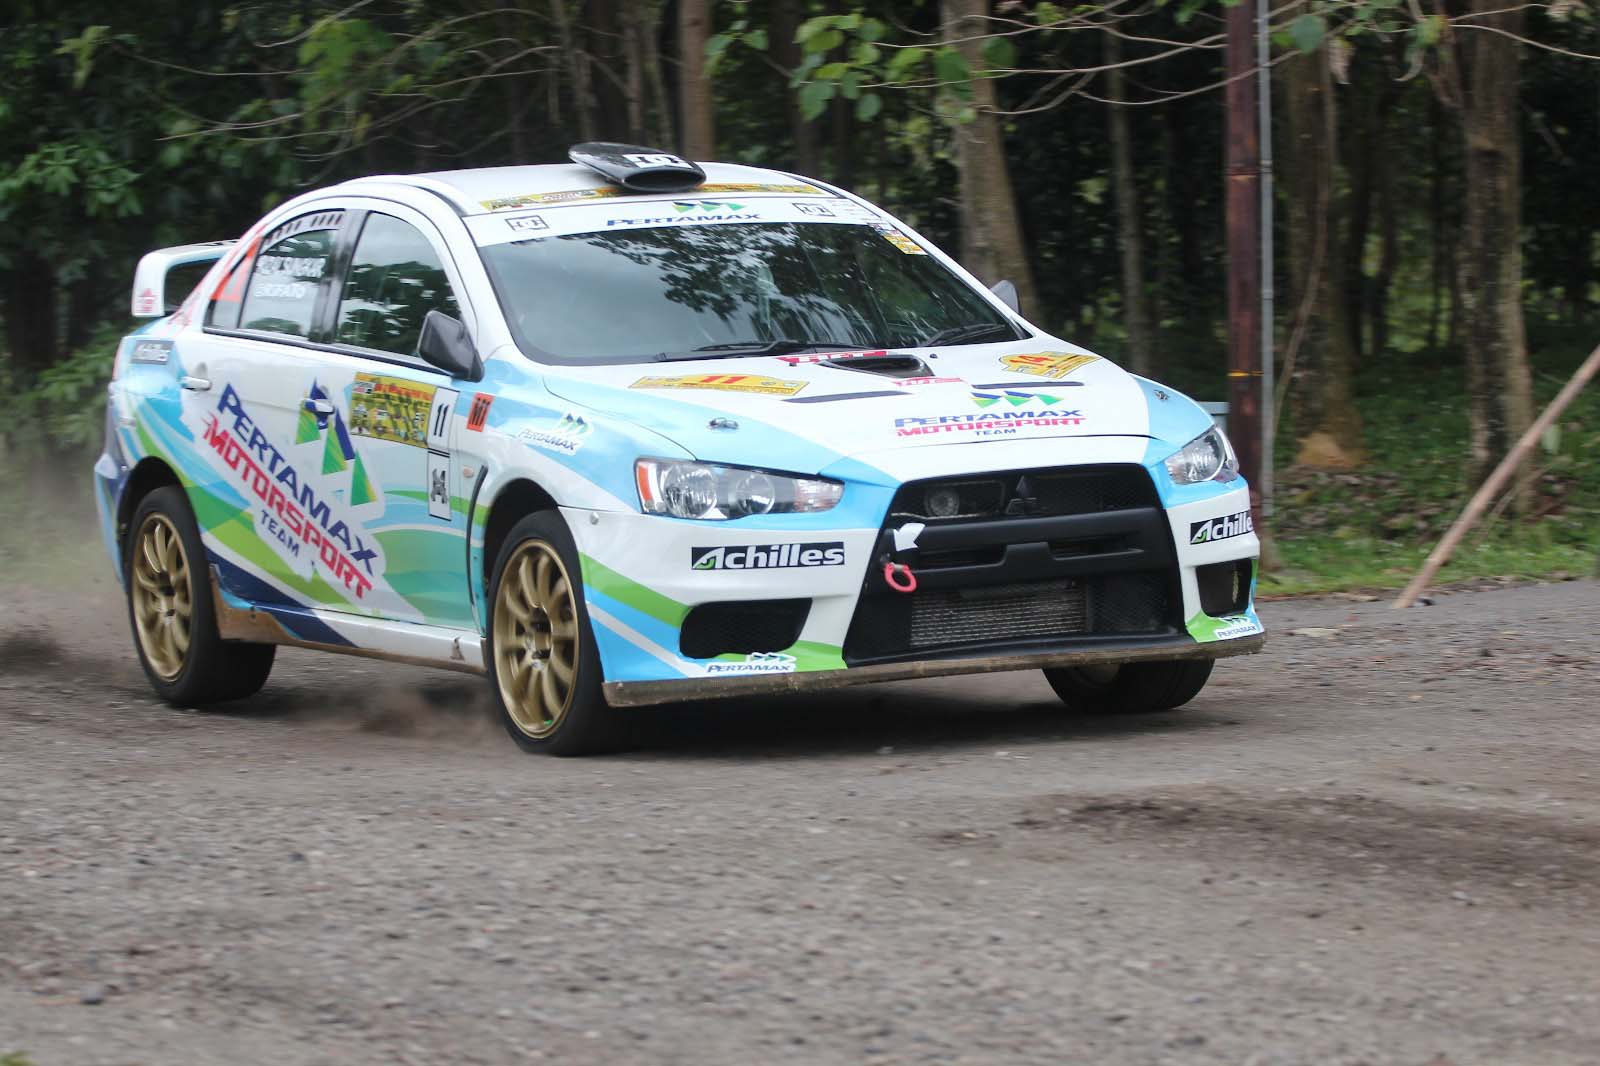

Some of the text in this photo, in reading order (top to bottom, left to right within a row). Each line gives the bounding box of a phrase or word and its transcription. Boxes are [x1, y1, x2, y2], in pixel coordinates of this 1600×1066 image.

[607, 212, 761, 226] PERTAMAX
[433, 403, 450, 437] 11
[895, 410, 1082, 427] PERTAMAX
[896, 418, 1086, 436] MOTORSPORT
[975, 428, 1016, 436] TEAM
[217, 383, 378, 576] PERTAMAX
[201, 410, 373, 599] MOTORSPORT
[260, 508, 300, 557] TEAM
[1191, 511, 1253, 543] Achille
[692, 544, 844, 569] Achilles
[707, 664, 790, 673] PERTAMAX
